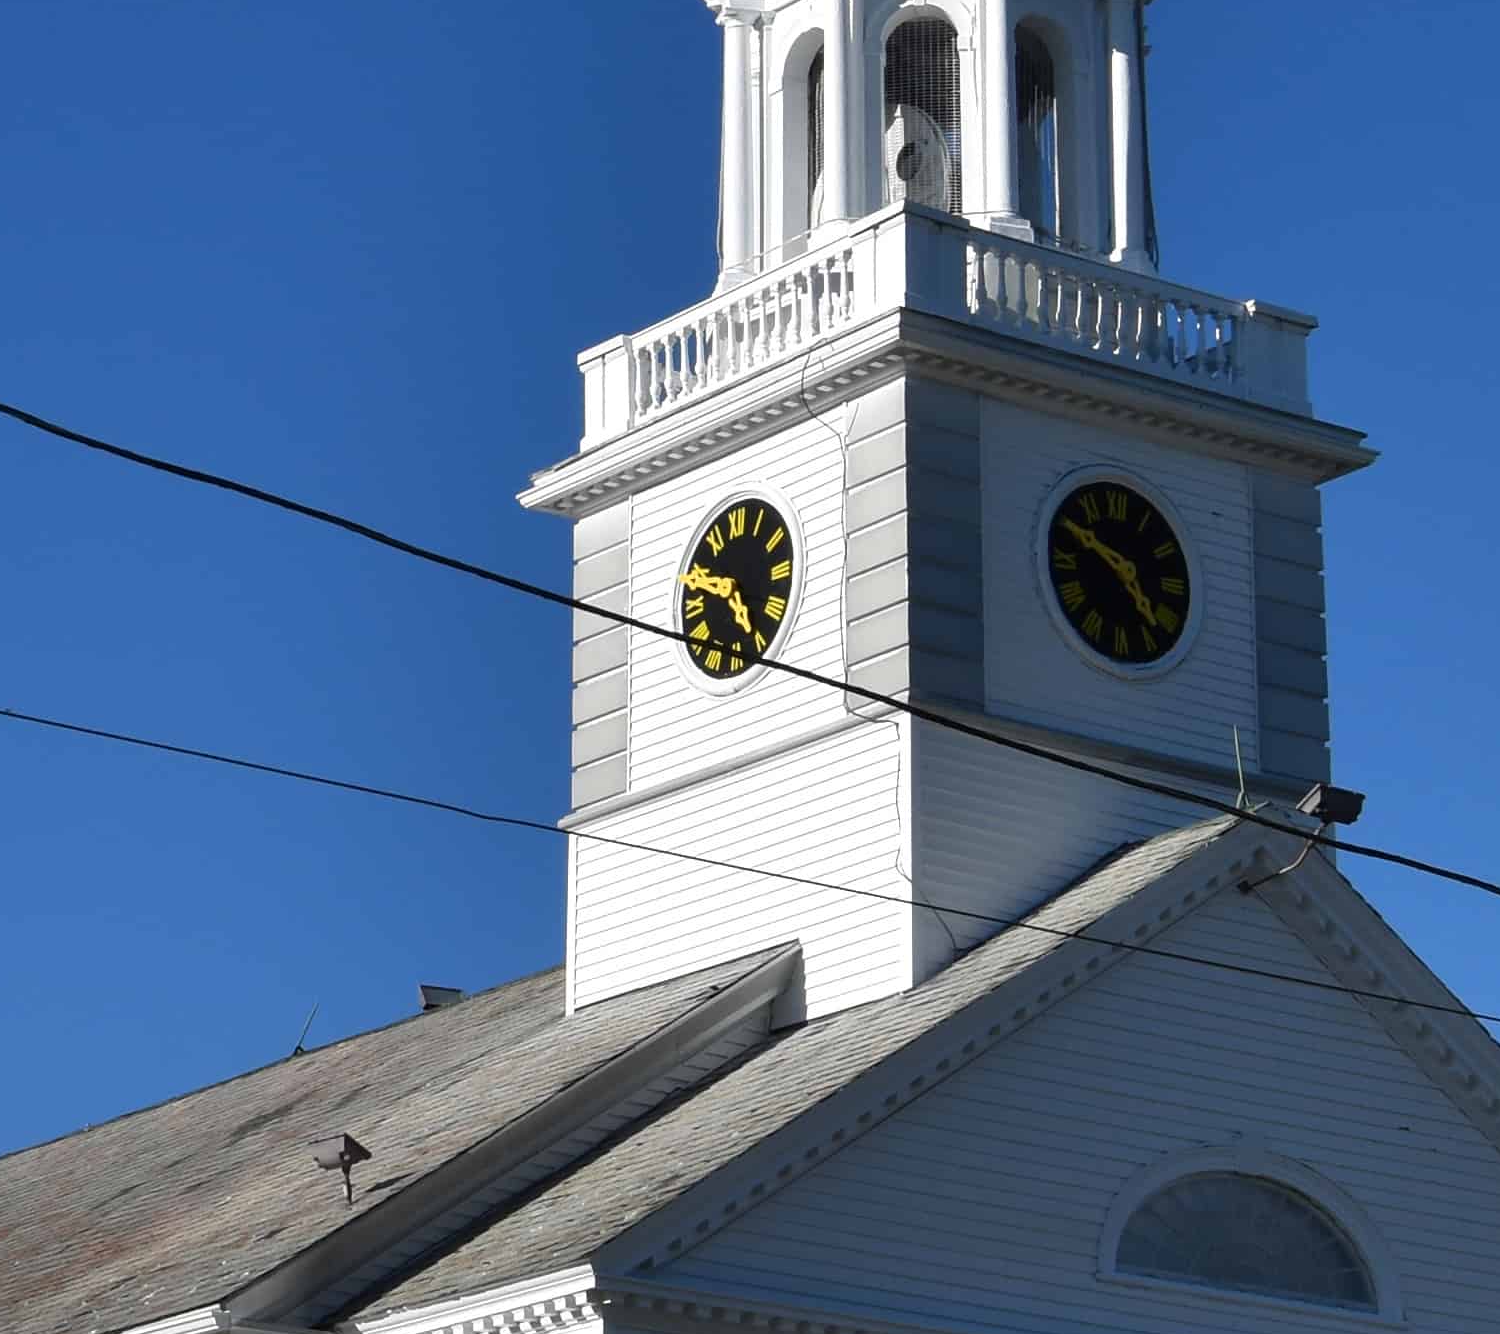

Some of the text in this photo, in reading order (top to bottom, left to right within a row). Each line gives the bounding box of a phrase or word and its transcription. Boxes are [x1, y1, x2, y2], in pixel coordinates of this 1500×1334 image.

[1079, 492, 1100, 524] XI
[1106, 490, 1127, 522] XII
[728, 507, 745, 540] XII
[706, 524, 724, 556] XI
[765, 527, 784, 552] II
[1153, 541, 1176, 559] II
[771, 560, 790, 581] III
[1160, 577, 1185, 595] III
[686, 595, 704, 619] IX
